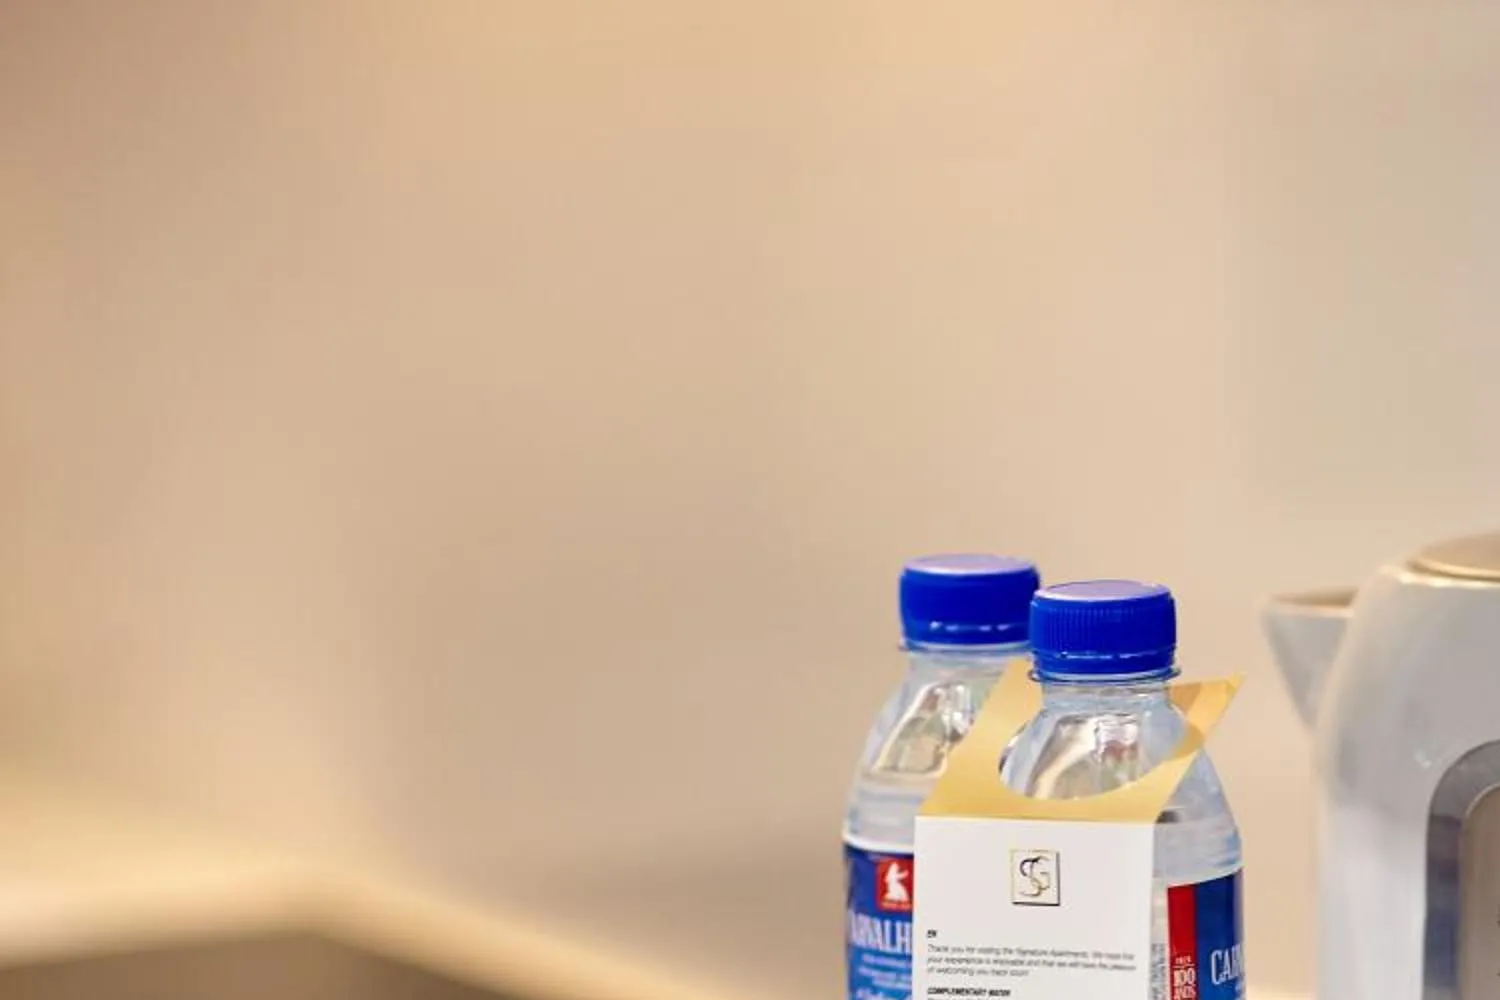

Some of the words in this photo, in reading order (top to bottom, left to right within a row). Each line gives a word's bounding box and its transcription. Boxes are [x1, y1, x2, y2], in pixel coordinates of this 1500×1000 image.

[927, 944, 948, 953] Thank
[951, 946, 964, 955] you
[1002, 947, 1013, 955] the
